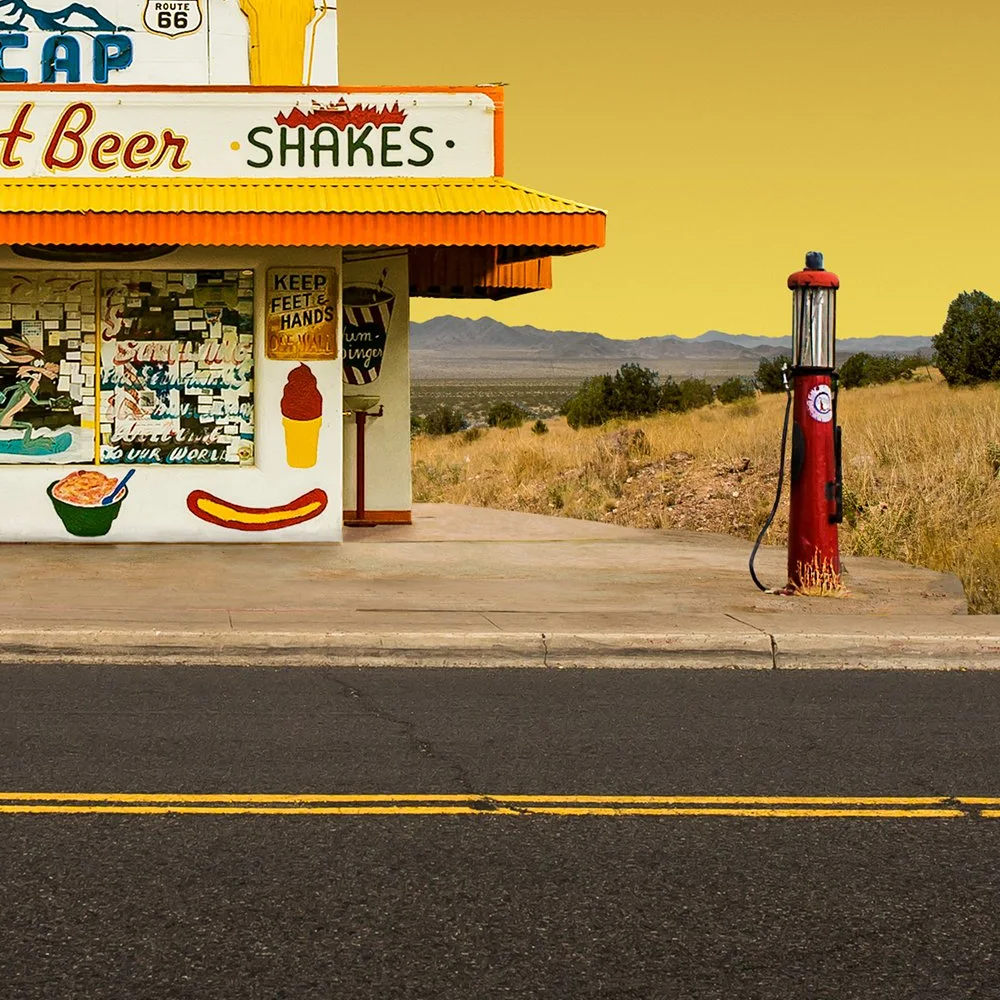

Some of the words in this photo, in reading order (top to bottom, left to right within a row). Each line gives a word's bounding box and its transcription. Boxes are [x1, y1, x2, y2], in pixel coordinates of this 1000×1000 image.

[154, 2, 190, 11] ROUTE
[157, 12, 188, 29] 66
[42, 101, 191, 174] Beer
[246, 125, 434, 168] SHAKES
[274, 274, 326, 290] KEEP
[271, 293, 312, 313] FEET
[317, 294, 329, 305] &
[281, 306, 334, 330] HANDS
[343, 326, 380, 343] um-
